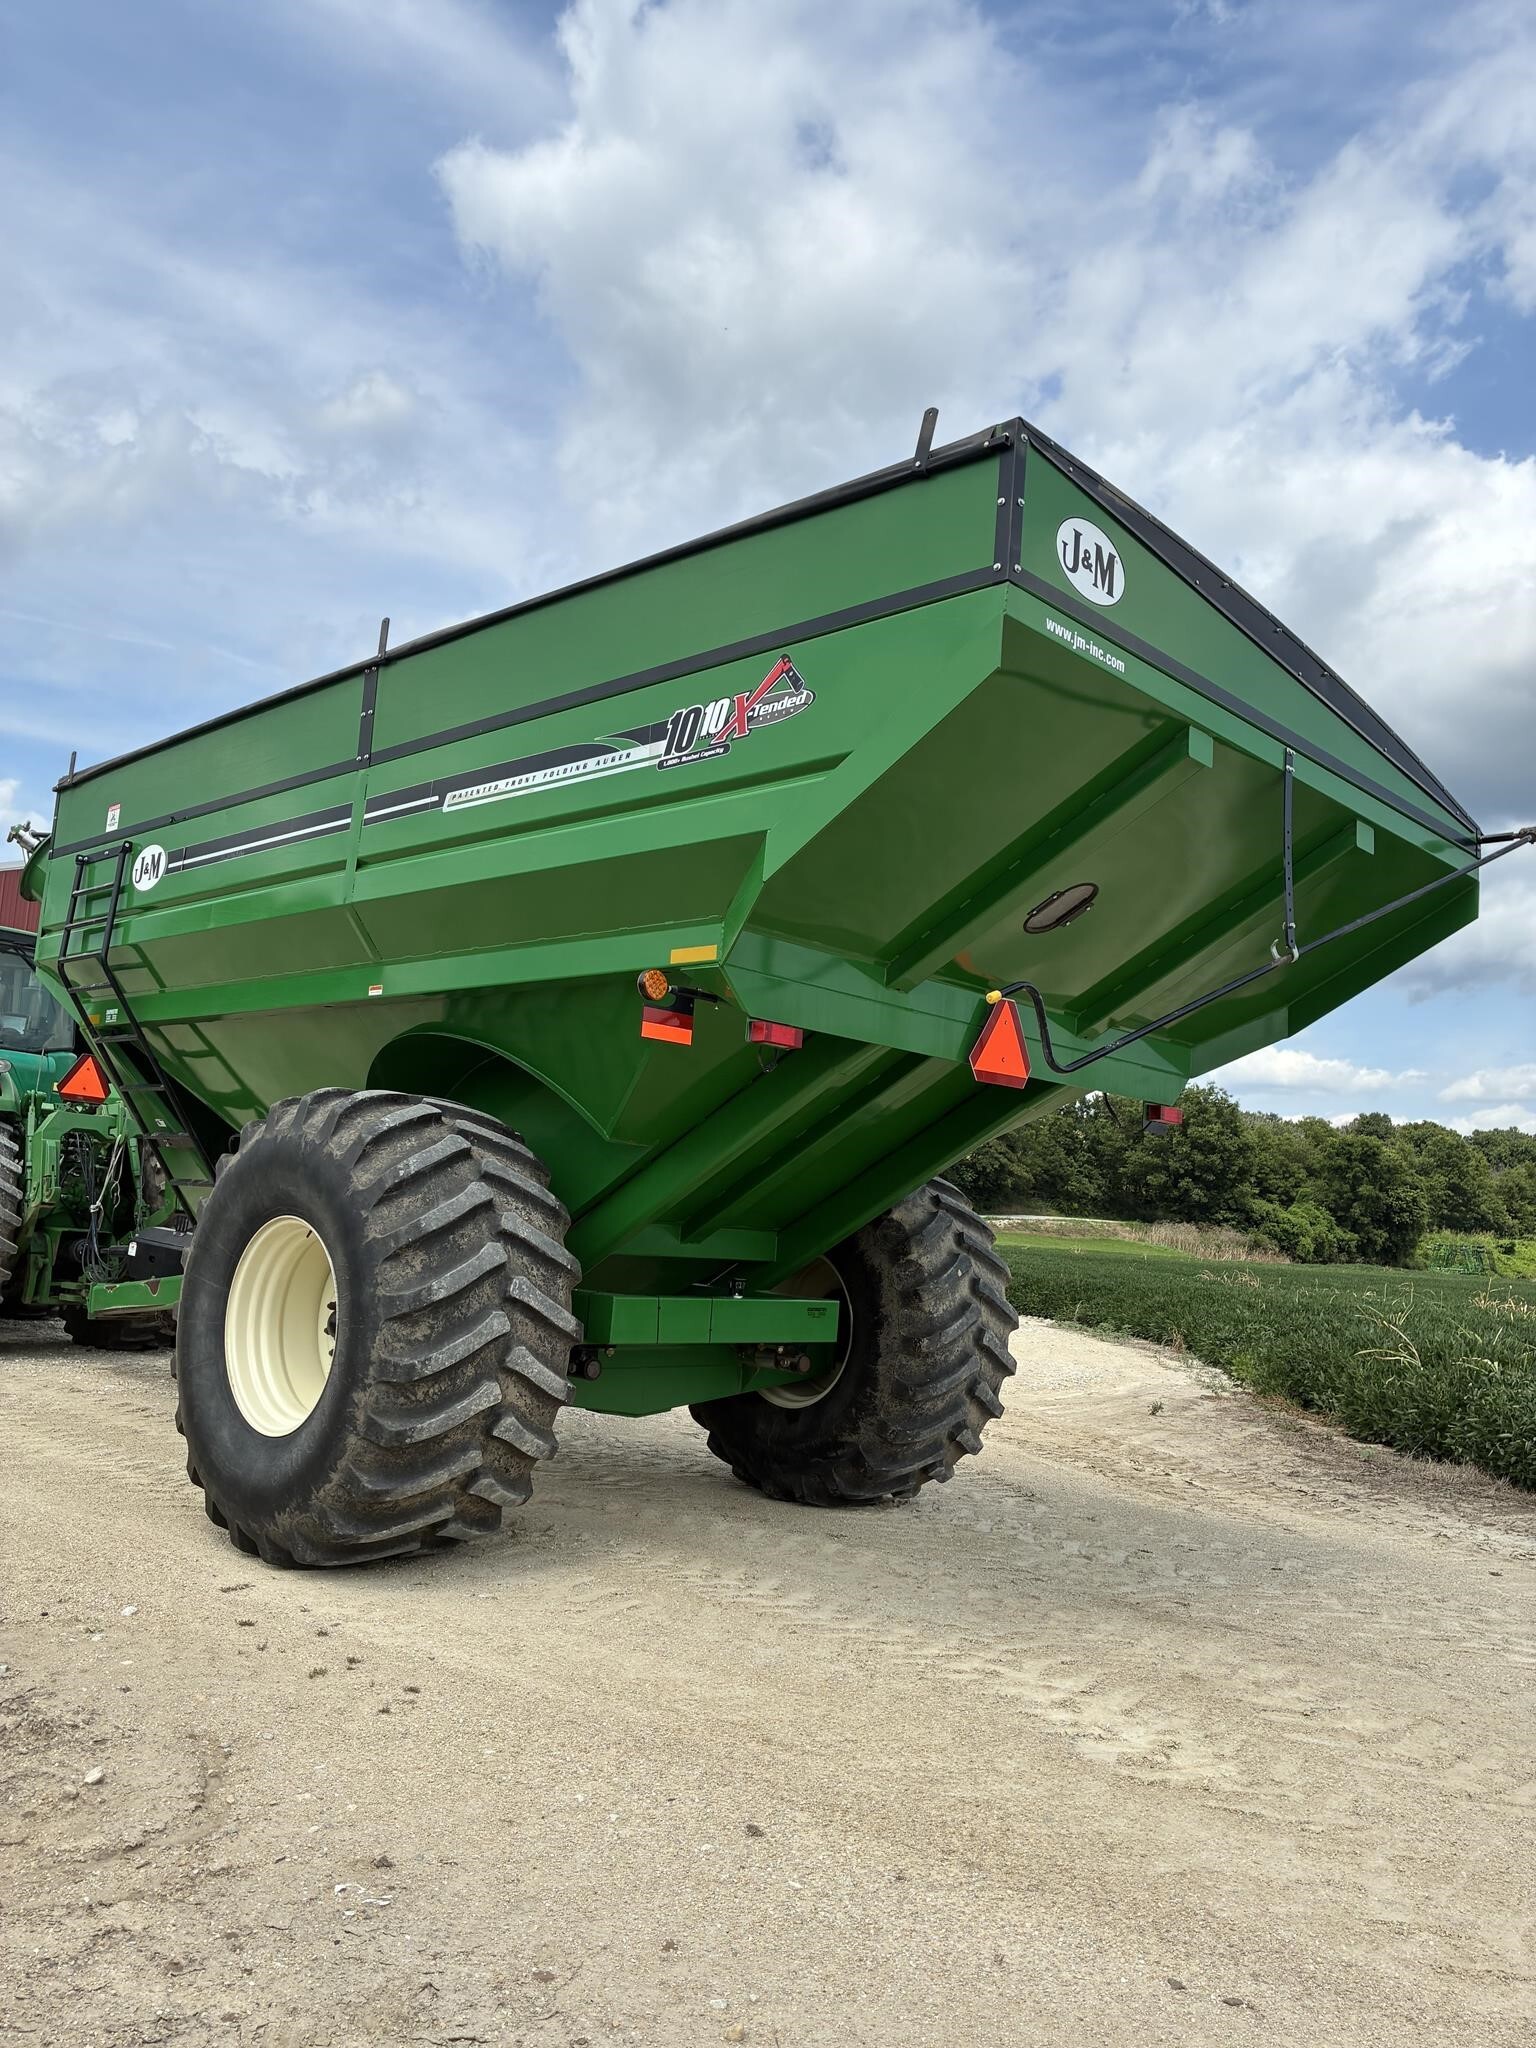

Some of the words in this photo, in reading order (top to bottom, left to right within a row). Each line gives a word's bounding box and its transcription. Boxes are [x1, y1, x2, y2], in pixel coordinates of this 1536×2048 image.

[1062, 528, 1117, 598] J&M
[1046, 617, 1125, 673] www.jm-inc.com
[452, 784, 499, 801] PATENTED
[505, 775, 536, 788] FRONT
[543, 764, 588, 779] FOLDING
[595, 752, 632, 767] AUGER
[700, 747, 725, 758] Capacity
[134, 852, 162, 884] J&M
